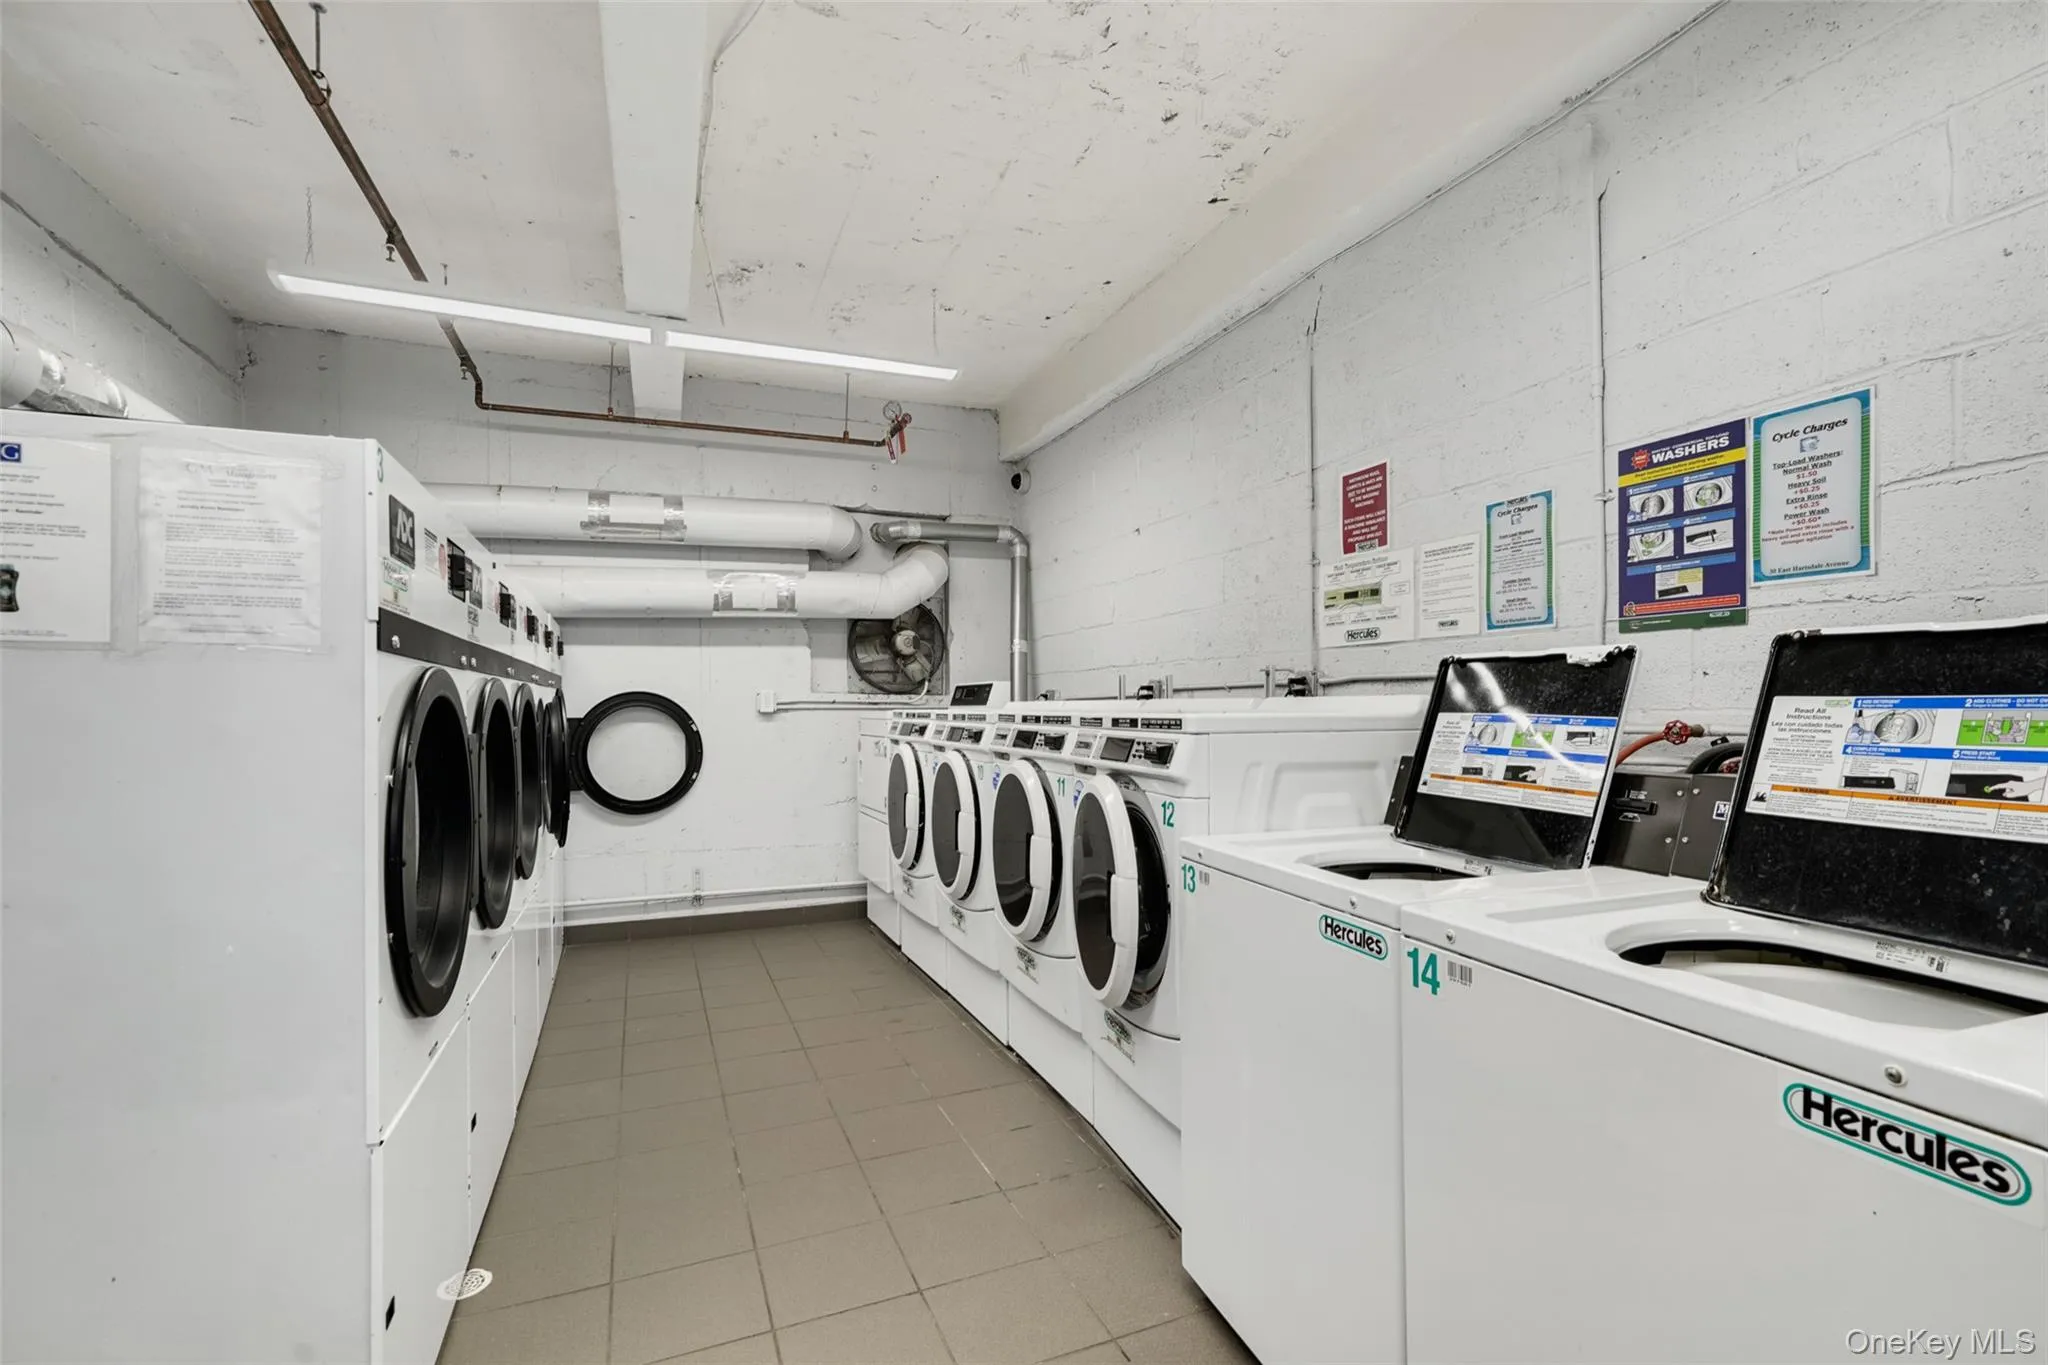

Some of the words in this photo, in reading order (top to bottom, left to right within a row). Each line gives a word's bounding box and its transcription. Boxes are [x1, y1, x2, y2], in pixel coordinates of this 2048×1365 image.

[1772, 429, 1800, 443] Cycle
[1802, 418, 1848, 435] Charges
[1652, 436, 1730, 464] WASHERS
[1772, 457, 1806, 470] Top-Load
[1808, 450, 1844, 461] Washers:
[376, 447, 384, 482] 3
[1783, 465, 1810, 476] Normal
[1811, 460, 1832, 470] Wash
[1788, 480, 1811, 489] Heavy
[1812, 476, 1827, 484] Soil
[1796, 471, 1817, 480] $1.50
[1513, 504, 1538, 513] Charges
[1786, 496, 1805, 505] Extra
[1807, 492, 1828, 500] Rinse
[1784, 510, 1807, 520] Power
[1809, 507, 1830, 516] Wash
[1346, 629, 1378, 640] Hercules
[1965, 698, 1973, 707] 2
[1057, 777, 1065, 797] 11
[1161, 800, 1174, 828] 12
[1181, 863, 1196, 893] 13
[1324, 916, 1383, 956] Hercules
[1407, 947, 1441, 996] 14
[1802, 1084, 2010, 1194] Hercules
